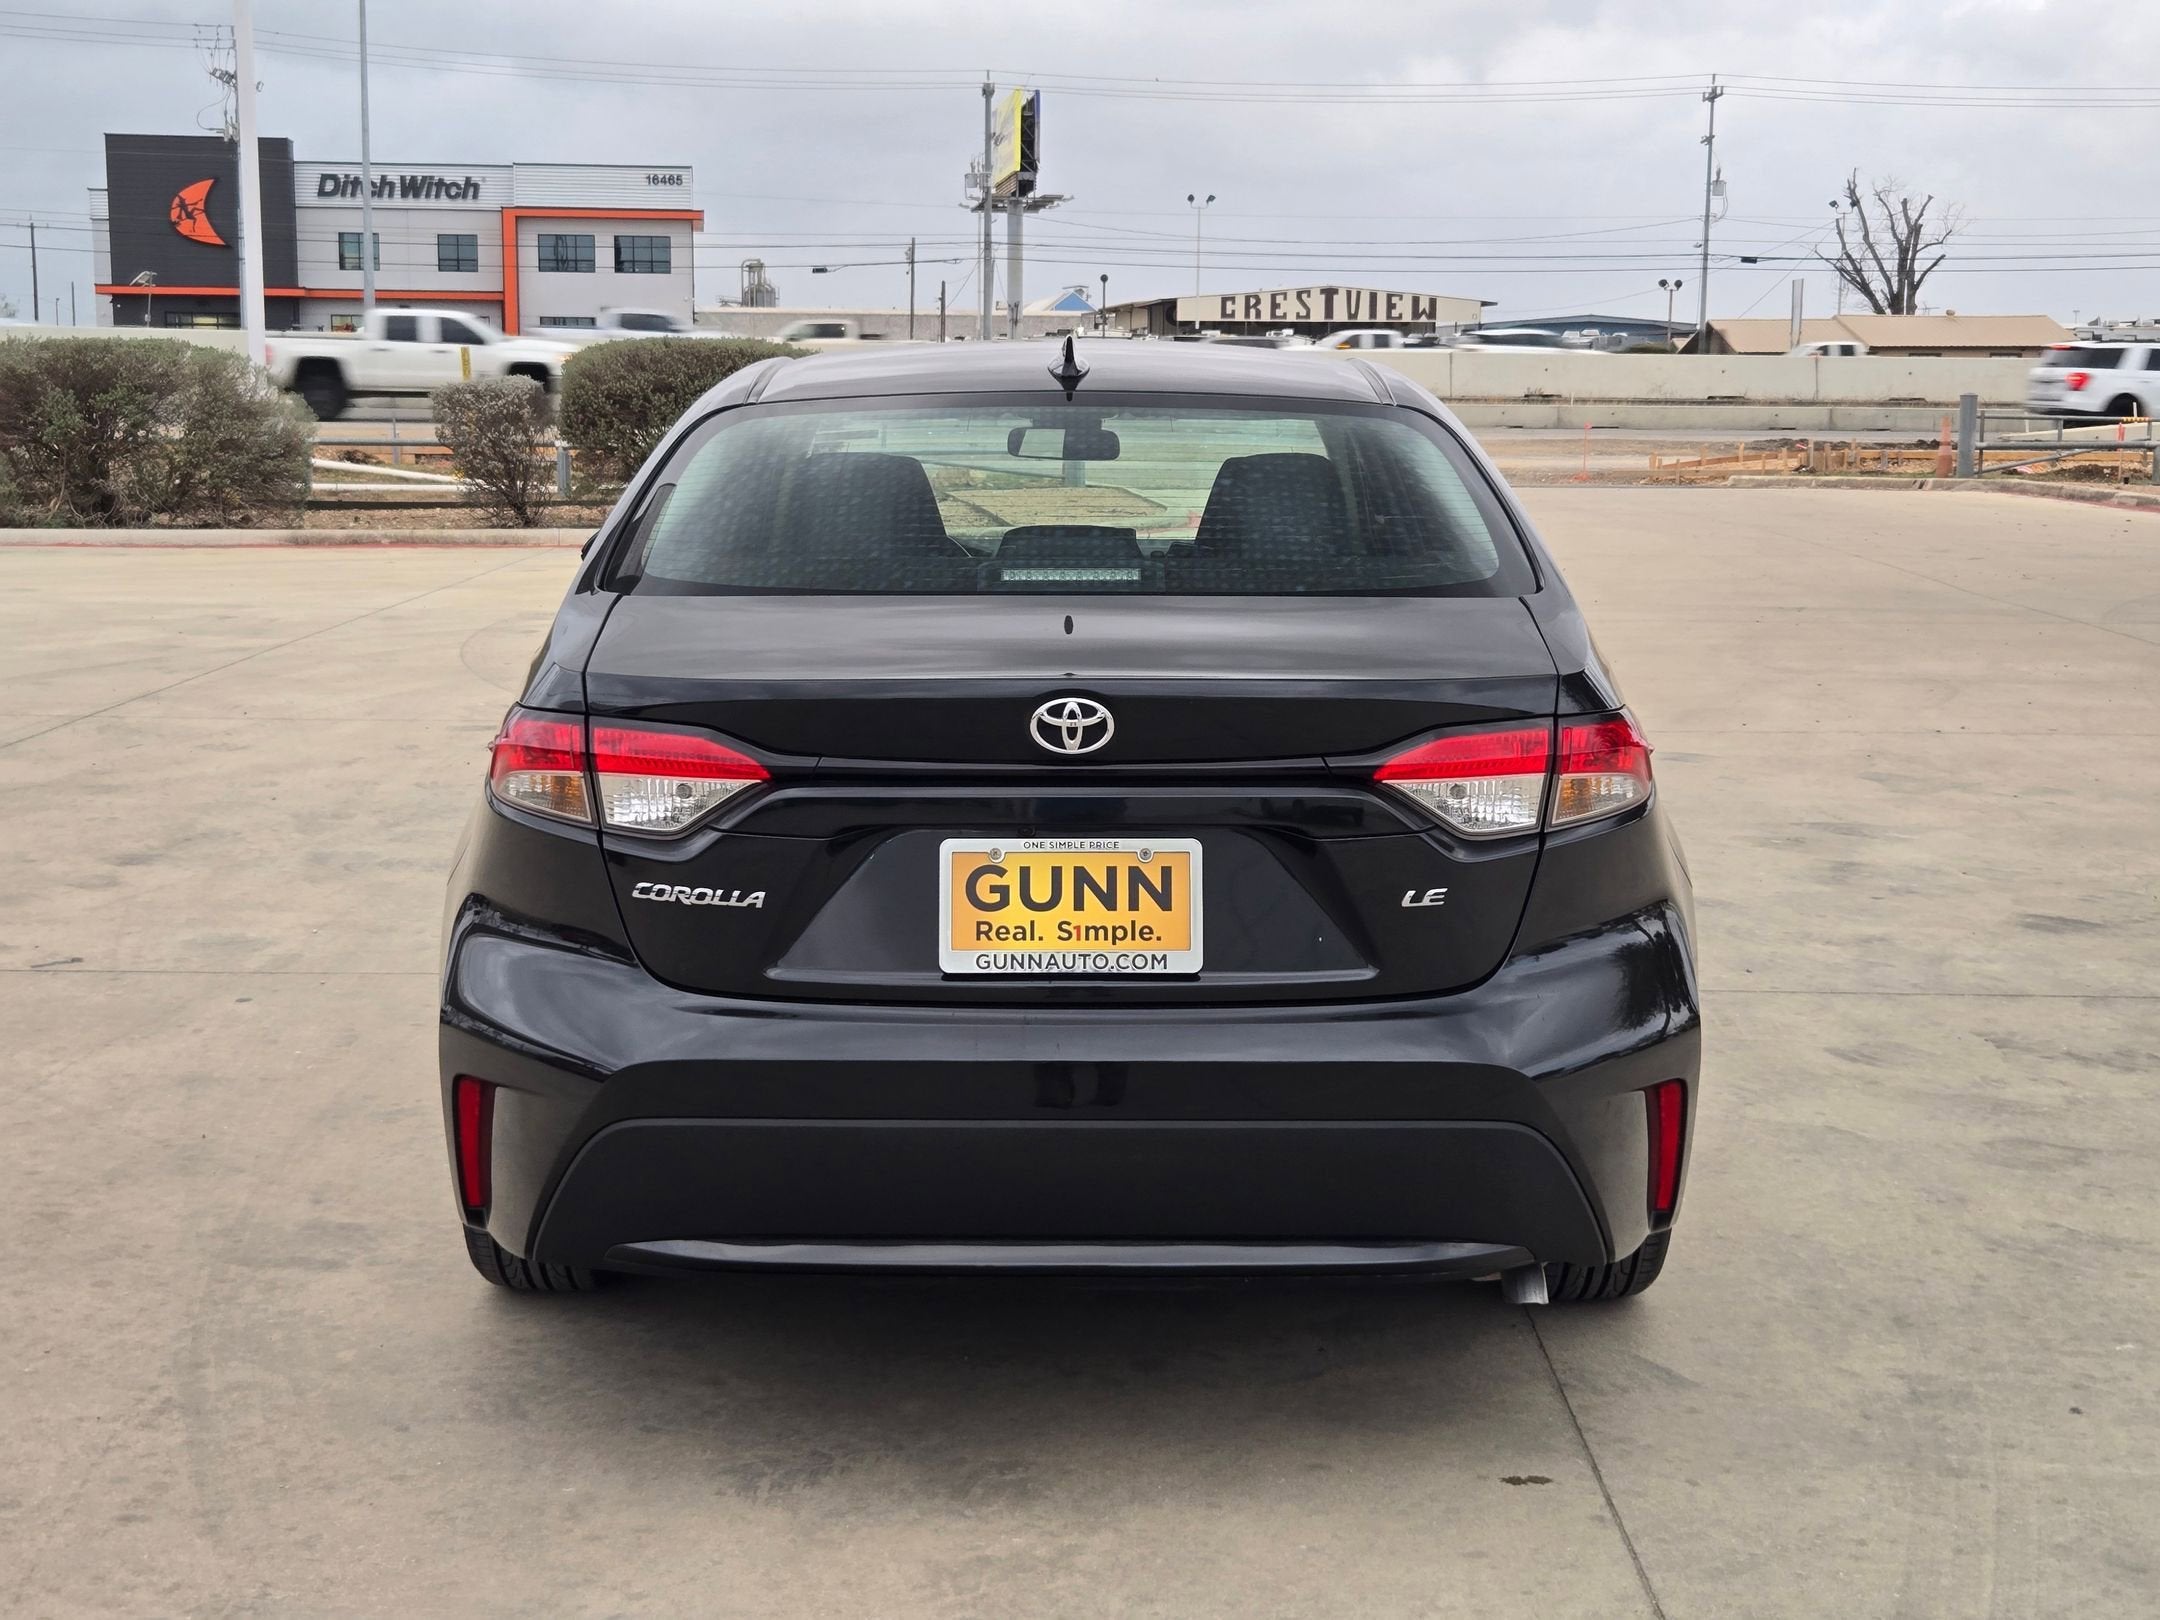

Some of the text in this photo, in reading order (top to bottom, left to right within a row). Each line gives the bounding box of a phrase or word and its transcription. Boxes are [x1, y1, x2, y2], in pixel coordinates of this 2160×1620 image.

[400, 175, 481, 200] Witch
[645, 173, 683, 186] 16465
[1220, 287, 1438, 321] CRESTVIEW
[1023, 841, 1120, 849] ONE SIMPLE PRICE
[631, 882, 766, 909] COROLLA
[965, 864, 1173, 912] GUNN
[1401, 887, 1449, 907] LE
[975, 920, 1044, 942] Real.
[975, 953, 1168, 970] GUNNAUTO.COM
